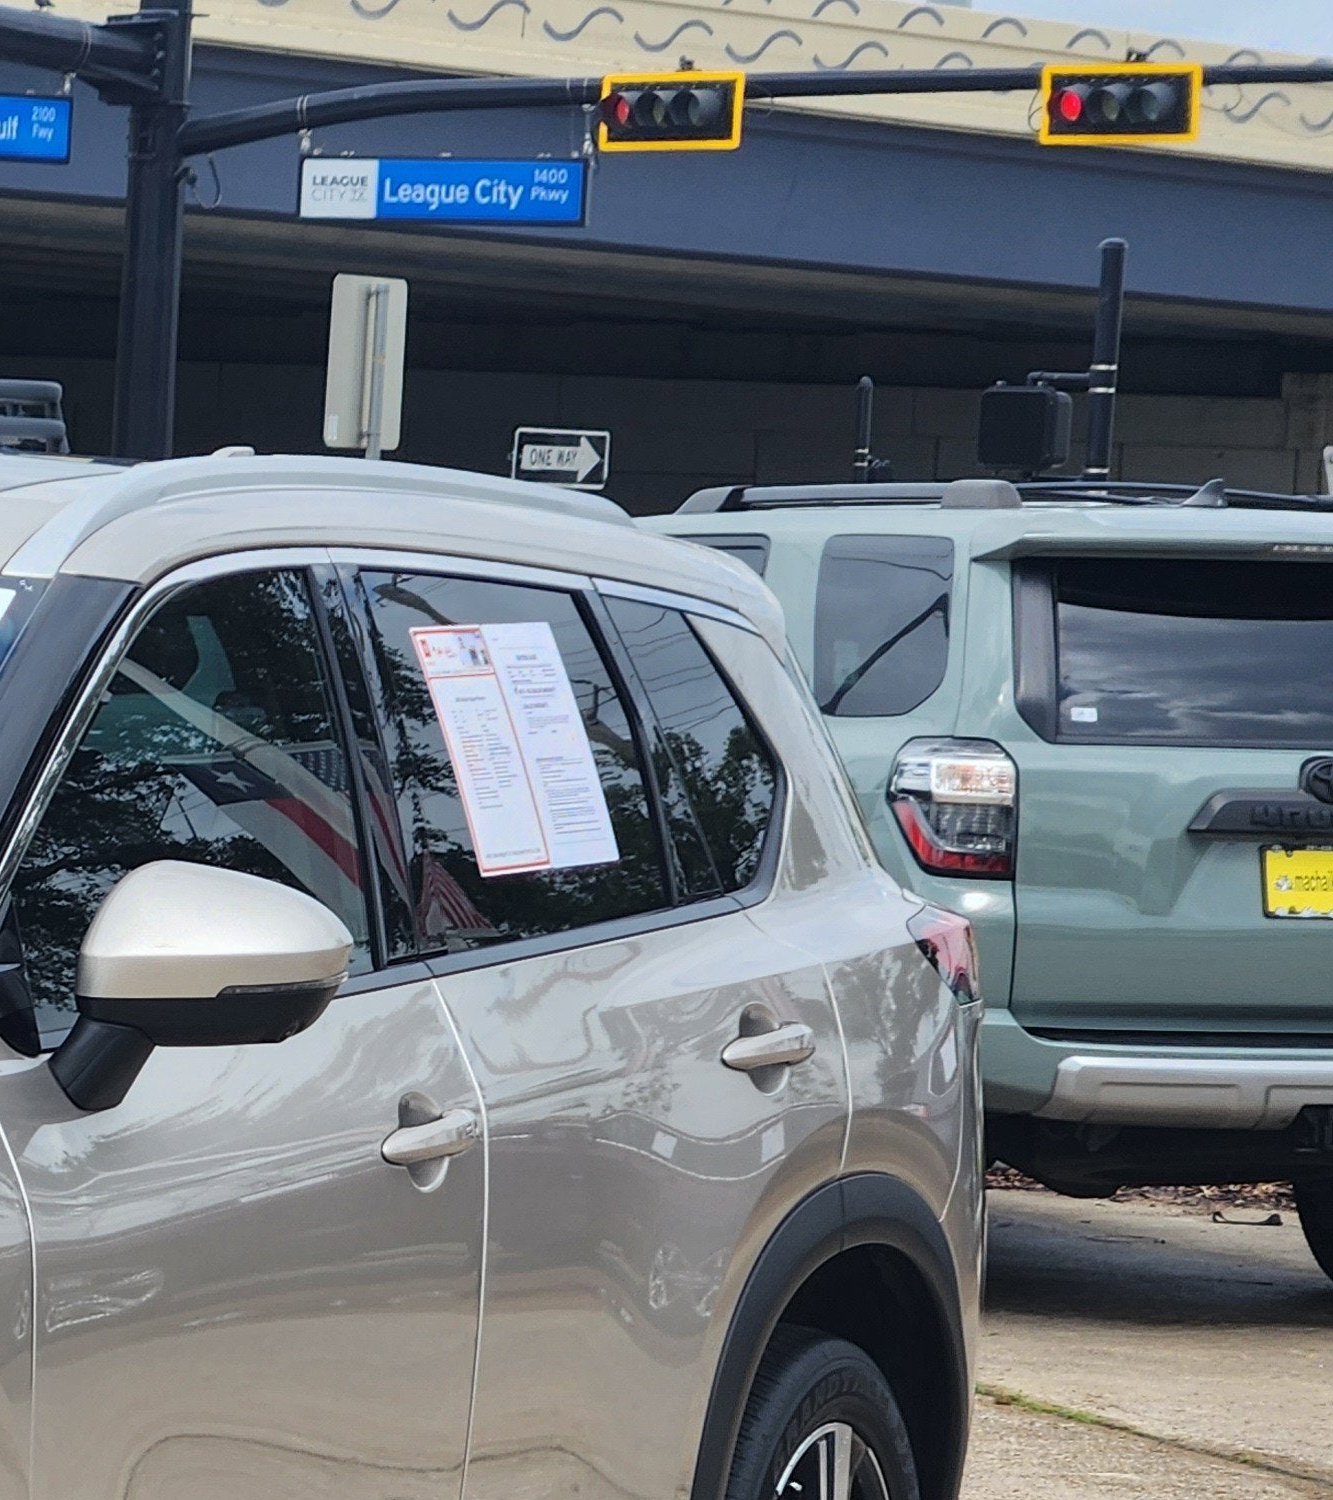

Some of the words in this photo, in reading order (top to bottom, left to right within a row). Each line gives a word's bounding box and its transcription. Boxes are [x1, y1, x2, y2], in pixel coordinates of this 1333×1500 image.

[31, 105, 57, 122] 2100
[31, 123, 54, 142] Fwy
[312, 175, 369, 187] LEAGUE
[533, 167, 569, 184] 1400
[311, 188, 346, 202] CITY
[384, 177, 470, 211] League
[474, 178, 525, 210] City
[529, 185, 570, 205] Pkwy
[529, 448, 553, 467] ONE
[556, 449, 578, 466] WAY
